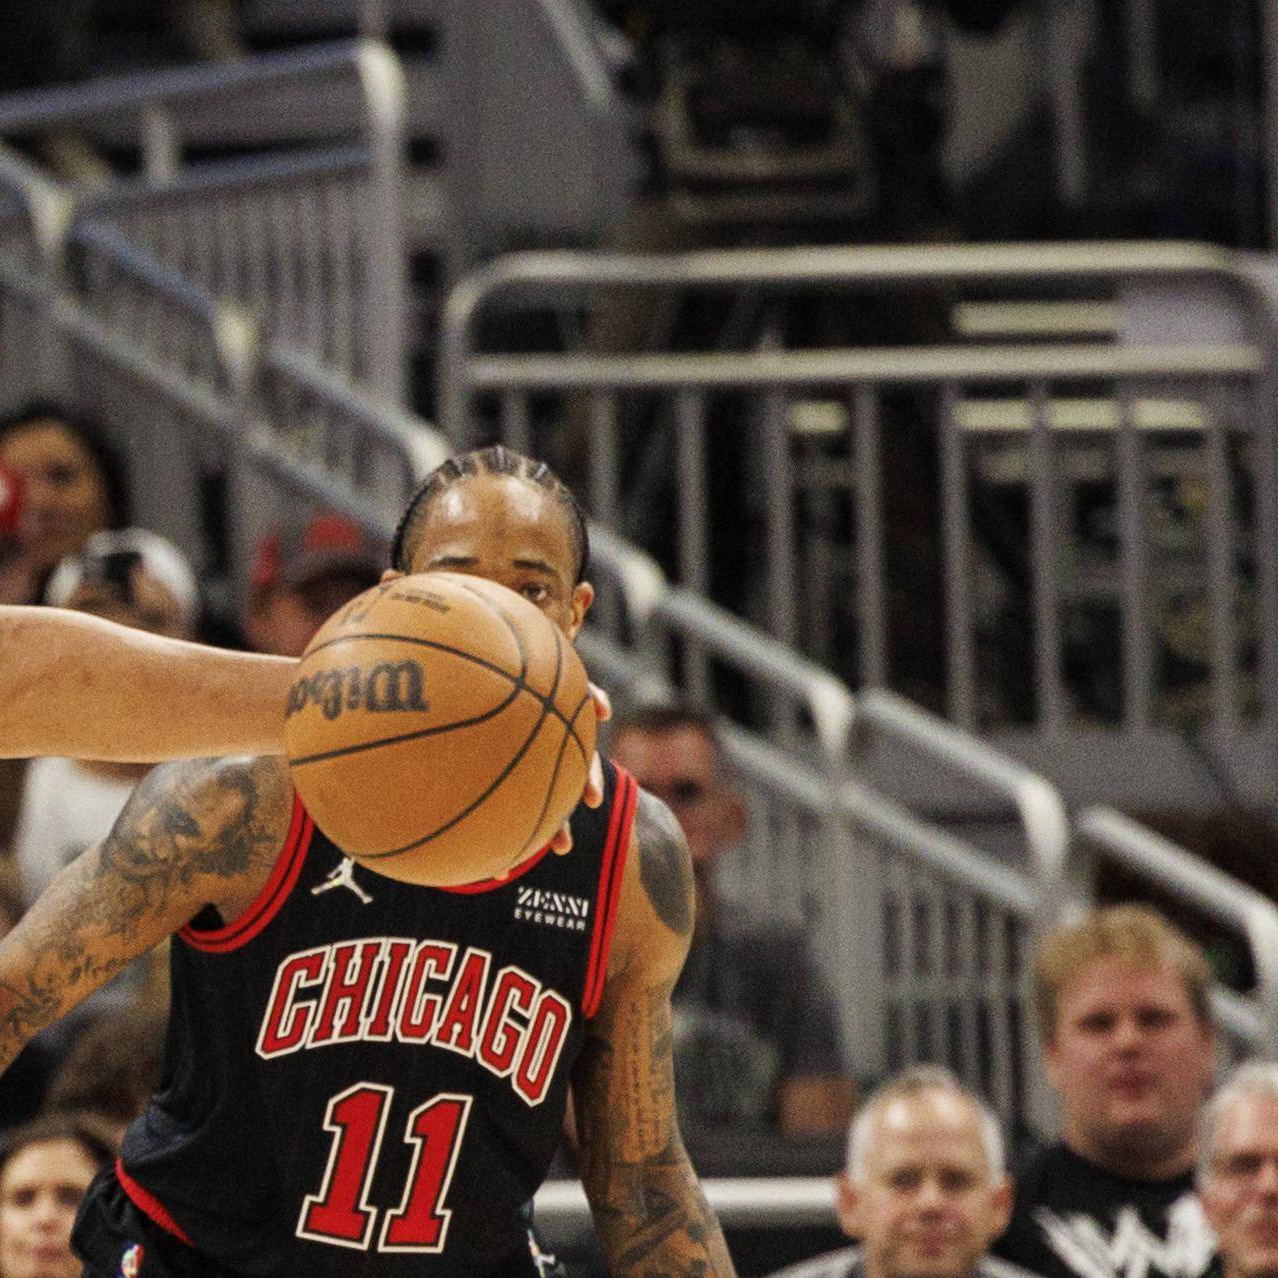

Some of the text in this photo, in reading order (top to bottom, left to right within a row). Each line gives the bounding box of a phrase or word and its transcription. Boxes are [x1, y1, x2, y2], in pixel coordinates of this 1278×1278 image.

[283, 658, 430, 721] Wilso
[514, 907, 586, 932] EYEWEAR
[517, 886, 589, 918] ZENNI
[255, 936, 572, 1106] CHICAGO
[295, 1081, 474, 1254] 11
